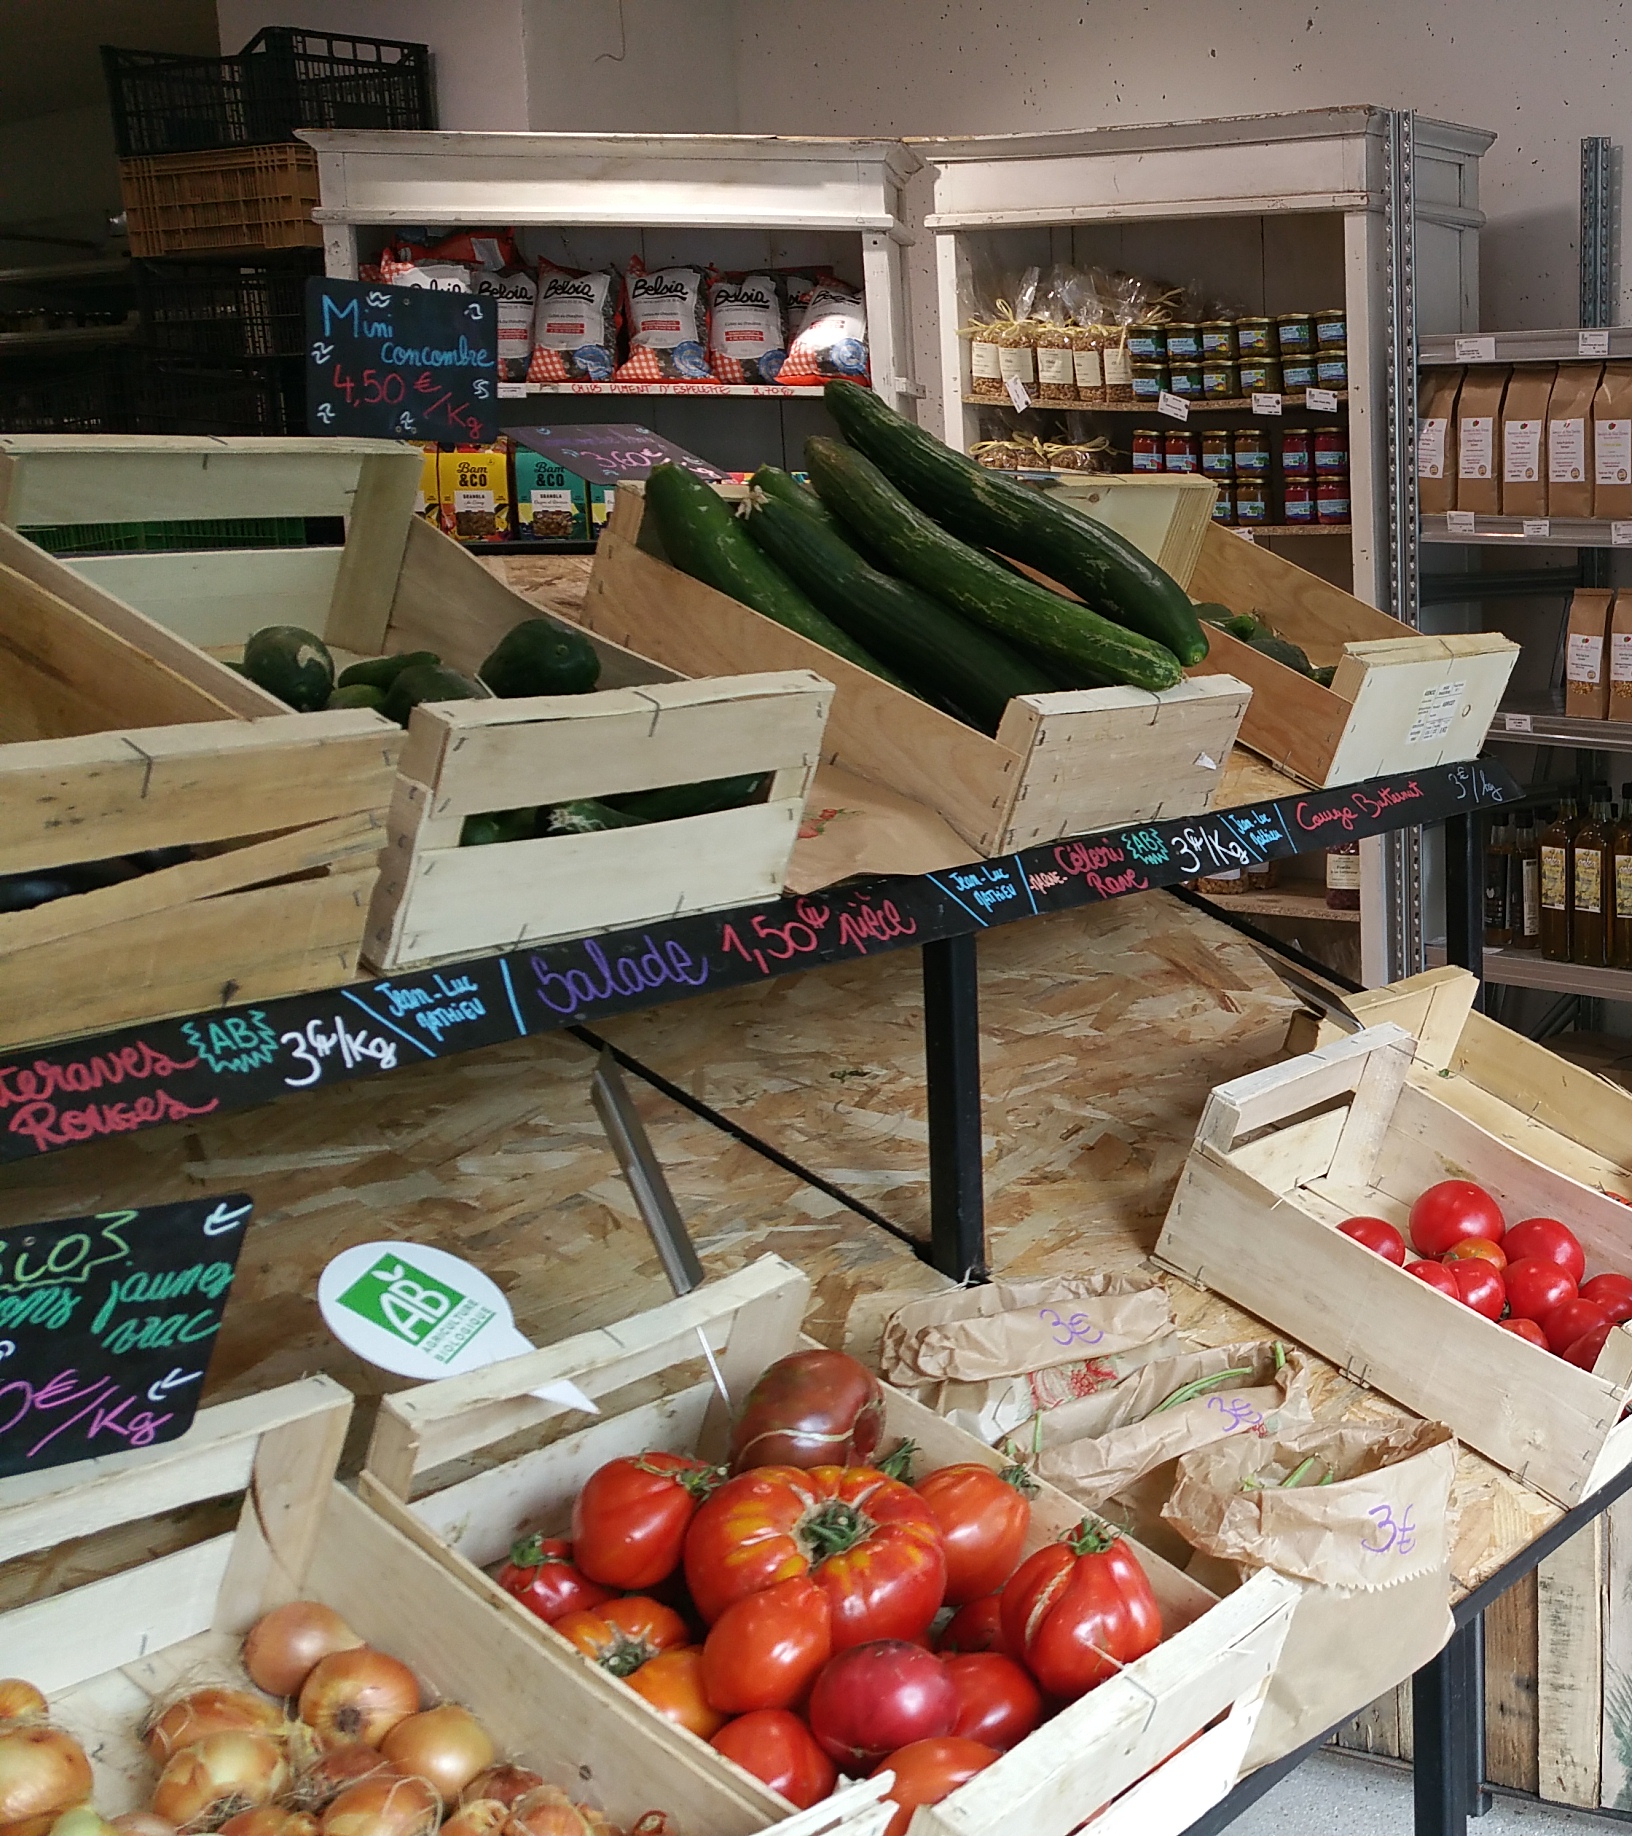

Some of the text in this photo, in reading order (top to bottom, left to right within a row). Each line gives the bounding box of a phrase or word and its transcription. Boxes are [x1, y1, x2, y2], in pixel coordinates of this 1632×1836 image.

[543, 278, 595, 298] Belsia
[632, 276, 689, 299] Belsia
[321, 293, 394, 339] Mini
[380, 334, 496, 368] concombre
[456, 461, 488, 474] Bam
[459, 473, 487, 487] &CO
[534, 461, 566, 474] Bam
[536, 473, 565, 487] &CO
[530, 936, 709, 1015] Salade
[209, 1015, 262, 1055] AB
[378, 1279, 452, 1342] AB
[421, 1298, 479, 1354] AGRICULTURE
[433, 1306, 495, 1363] BIOLOGIQUE
